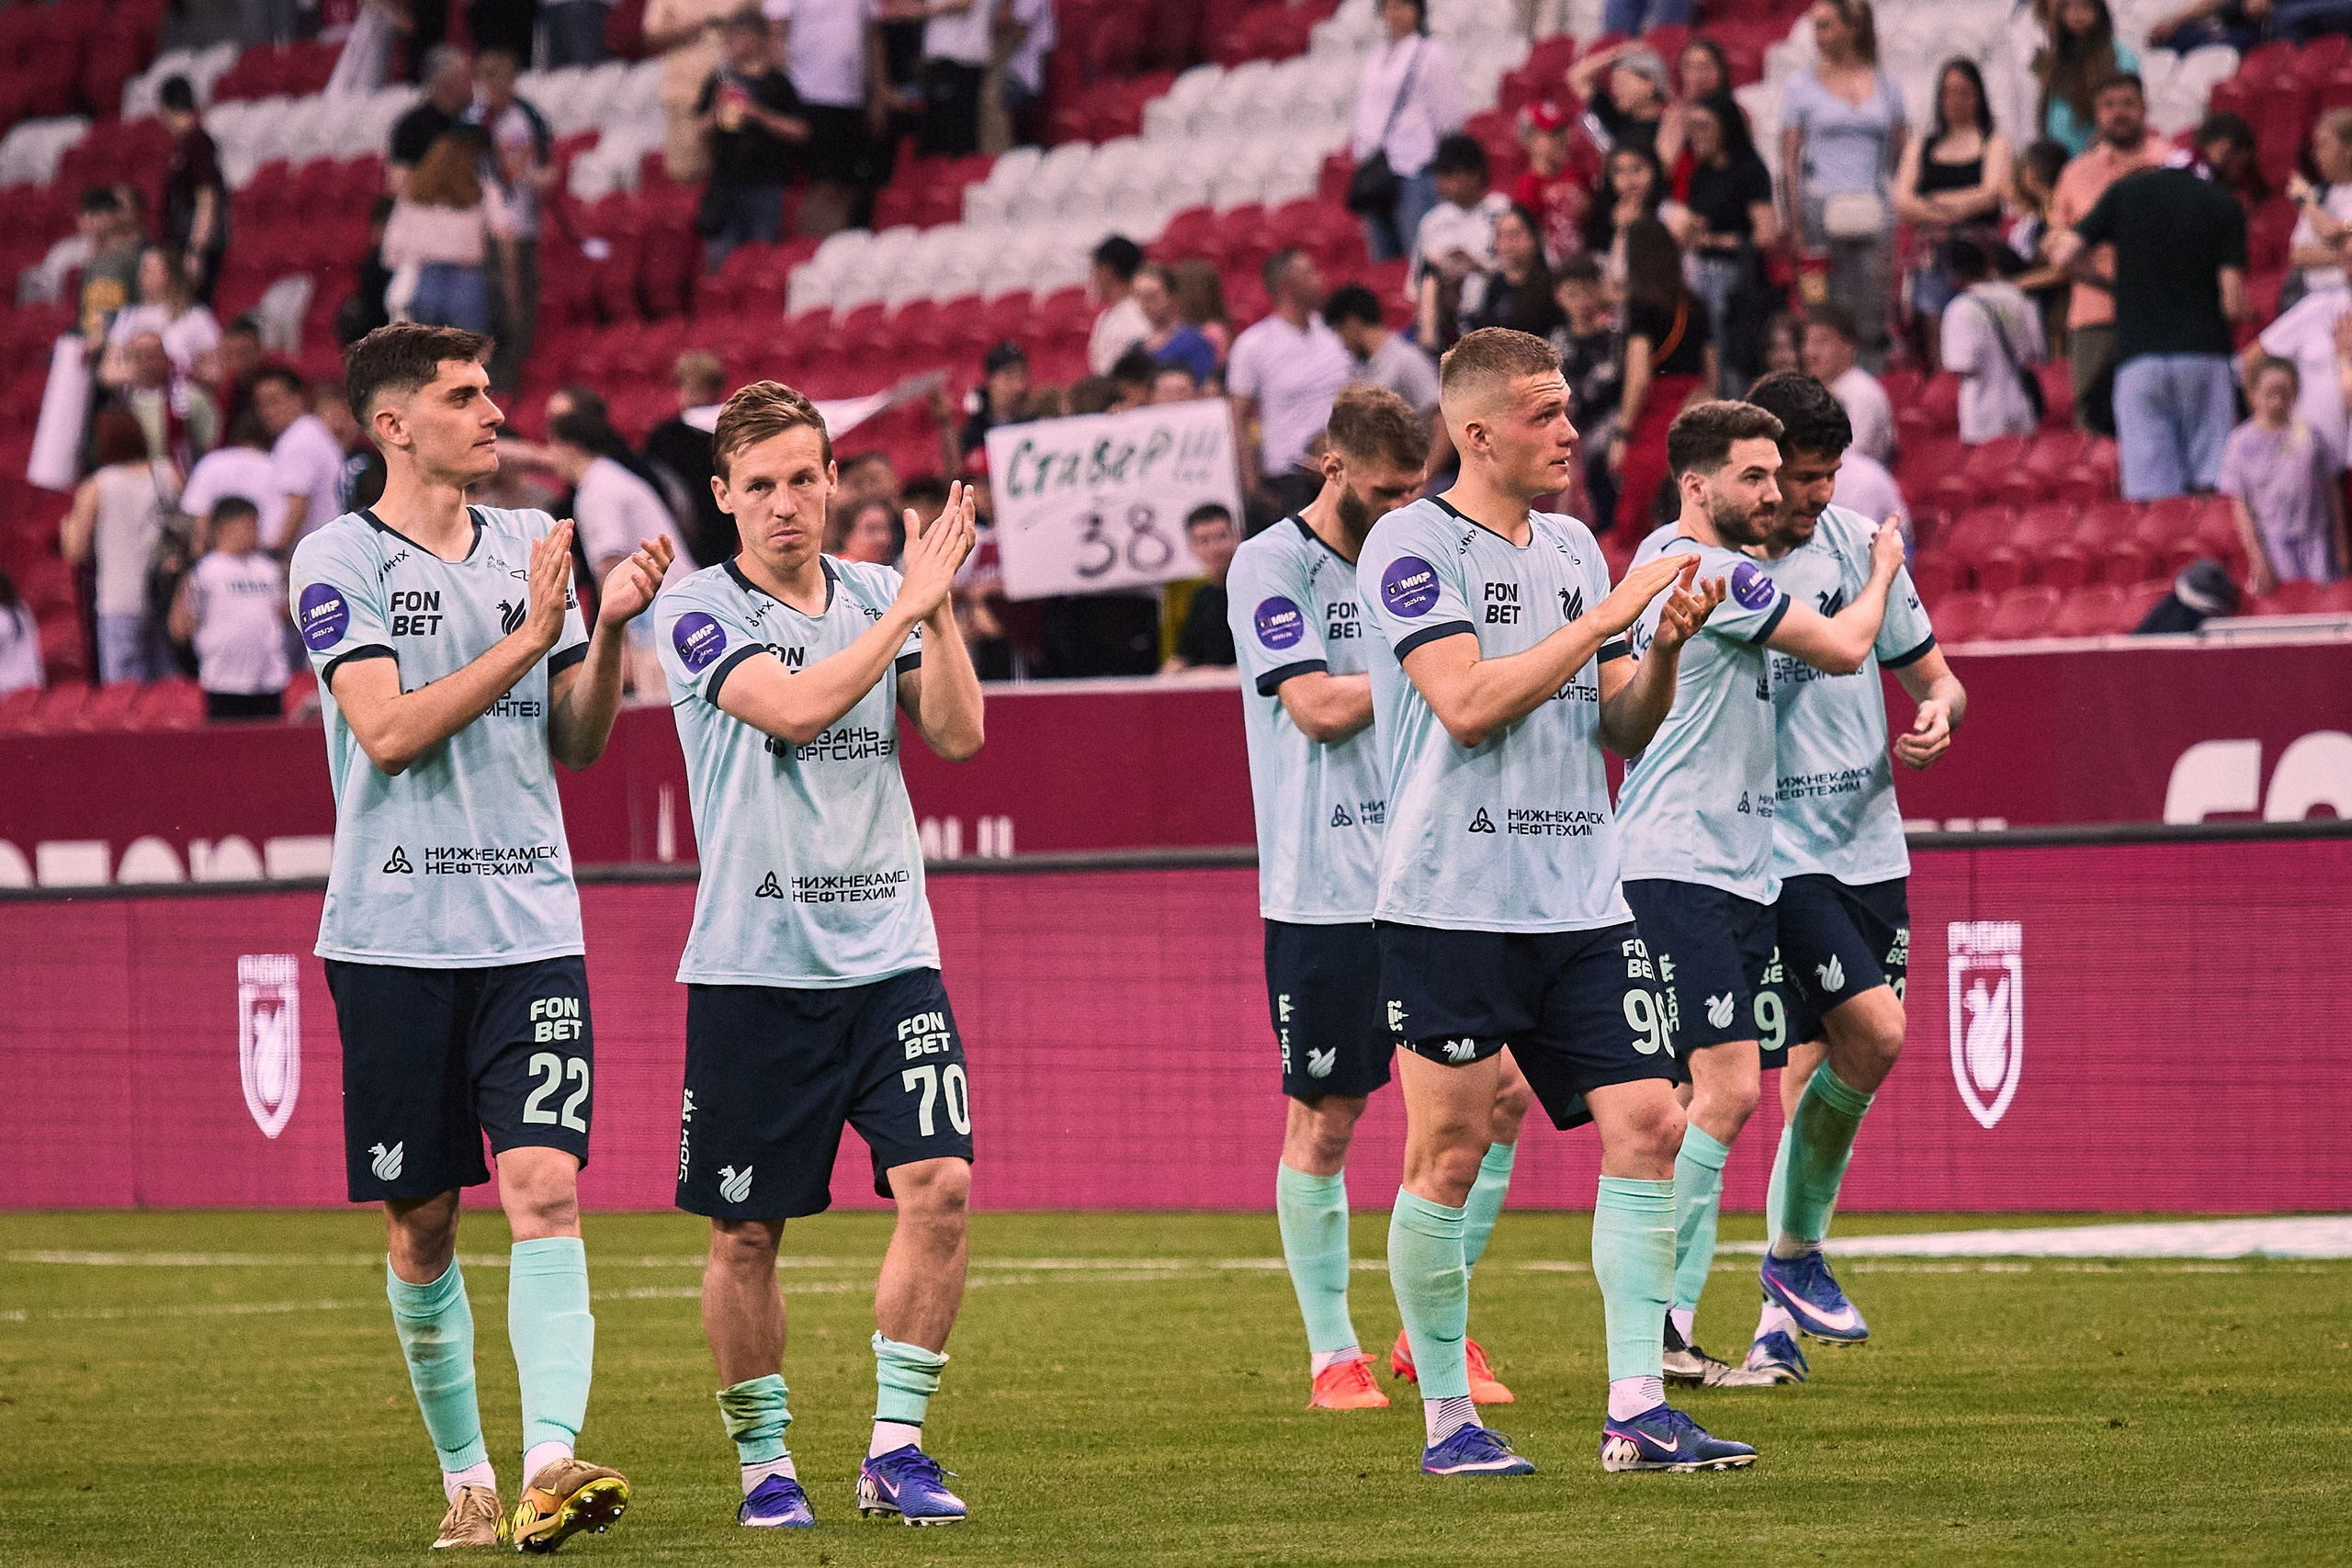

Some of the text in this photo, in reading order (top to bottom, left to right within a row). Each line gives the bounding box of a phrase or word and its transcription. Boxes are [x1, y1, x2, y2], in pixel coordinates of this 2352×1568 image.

[1077, 502, 1174, 579] 38
[1401, 571, 1430, 589] МИР
[390, 591, 440, 612] FON
[1484, 582, 1518, 602] FON
[311, 599, 340, 618] МИР
[1485, 604, 1521, 624] BET
[391, 615, 443, 637] BET
[814, 727, 879, 745] ЗАНЬ
[424, 845, 560, 861] НИЖНЕКАМСК
[425, 862, 534, 875] НЕФТЕХИМ
[792, 886, 896, 904] НЕФТЕХИМ
[530, 997, 580, 1021] FON
[534, 1020, 582, 1043] BET
[898, 1011, 946, 1041] FON
[905, 1032, 951, 1060] BET
[523, 1052, 590, 1134] 22
[902, 1063, 971, 1137] 70
